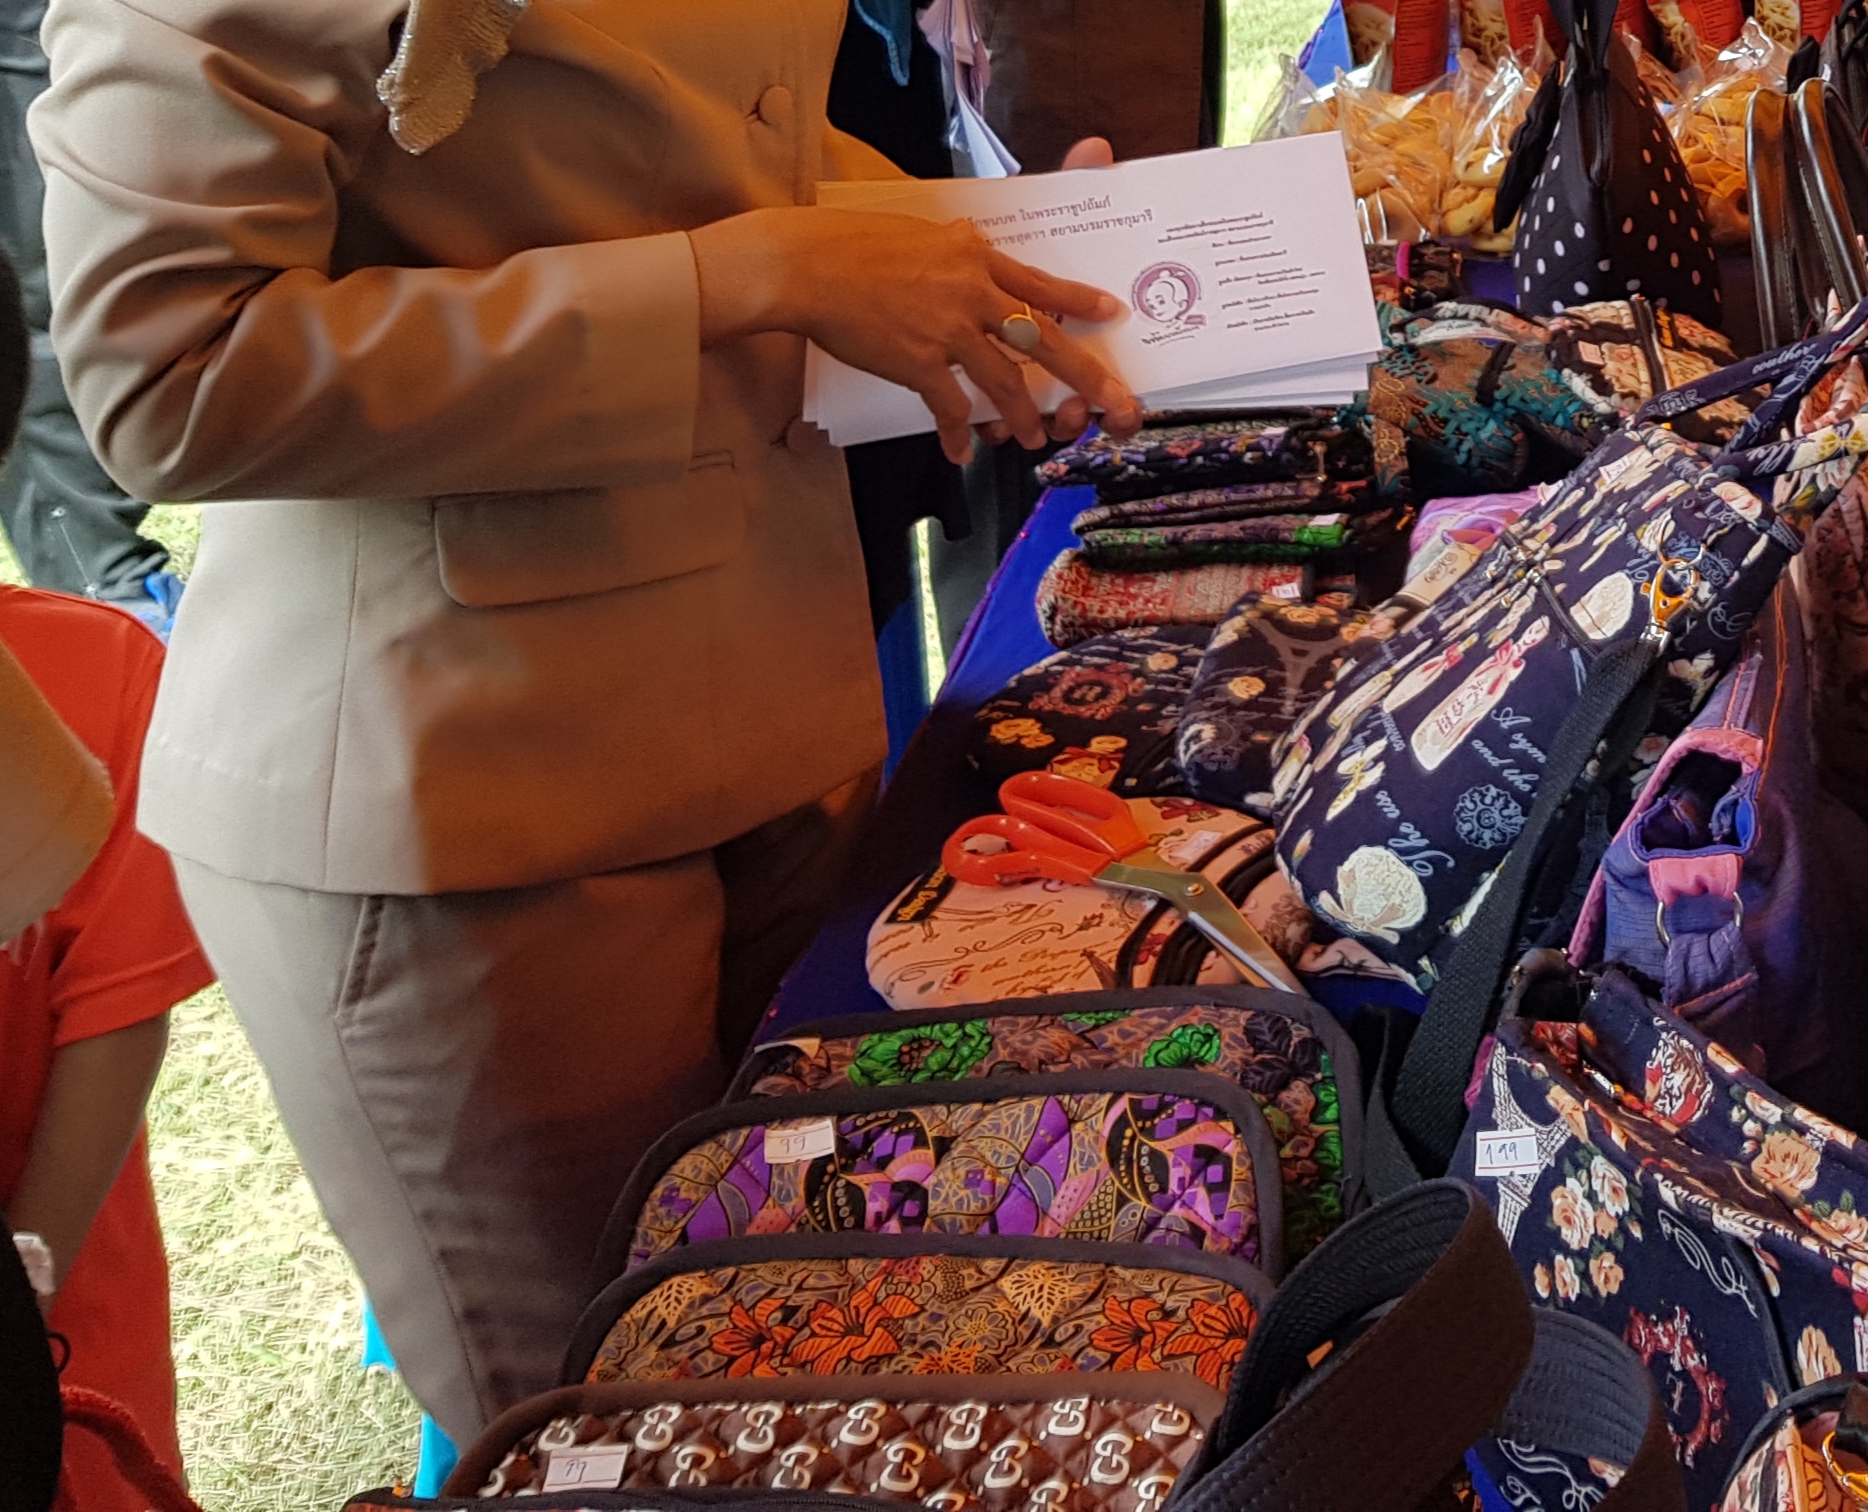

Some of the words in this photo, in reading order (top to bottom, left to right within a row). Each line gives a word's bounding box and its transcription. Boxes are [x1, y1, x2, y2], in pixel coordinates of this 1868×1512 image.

[1471, 739, 1516, 767] and
[1502, 768, 1540, 792] the
[1387, 821, 1456, 878] The
